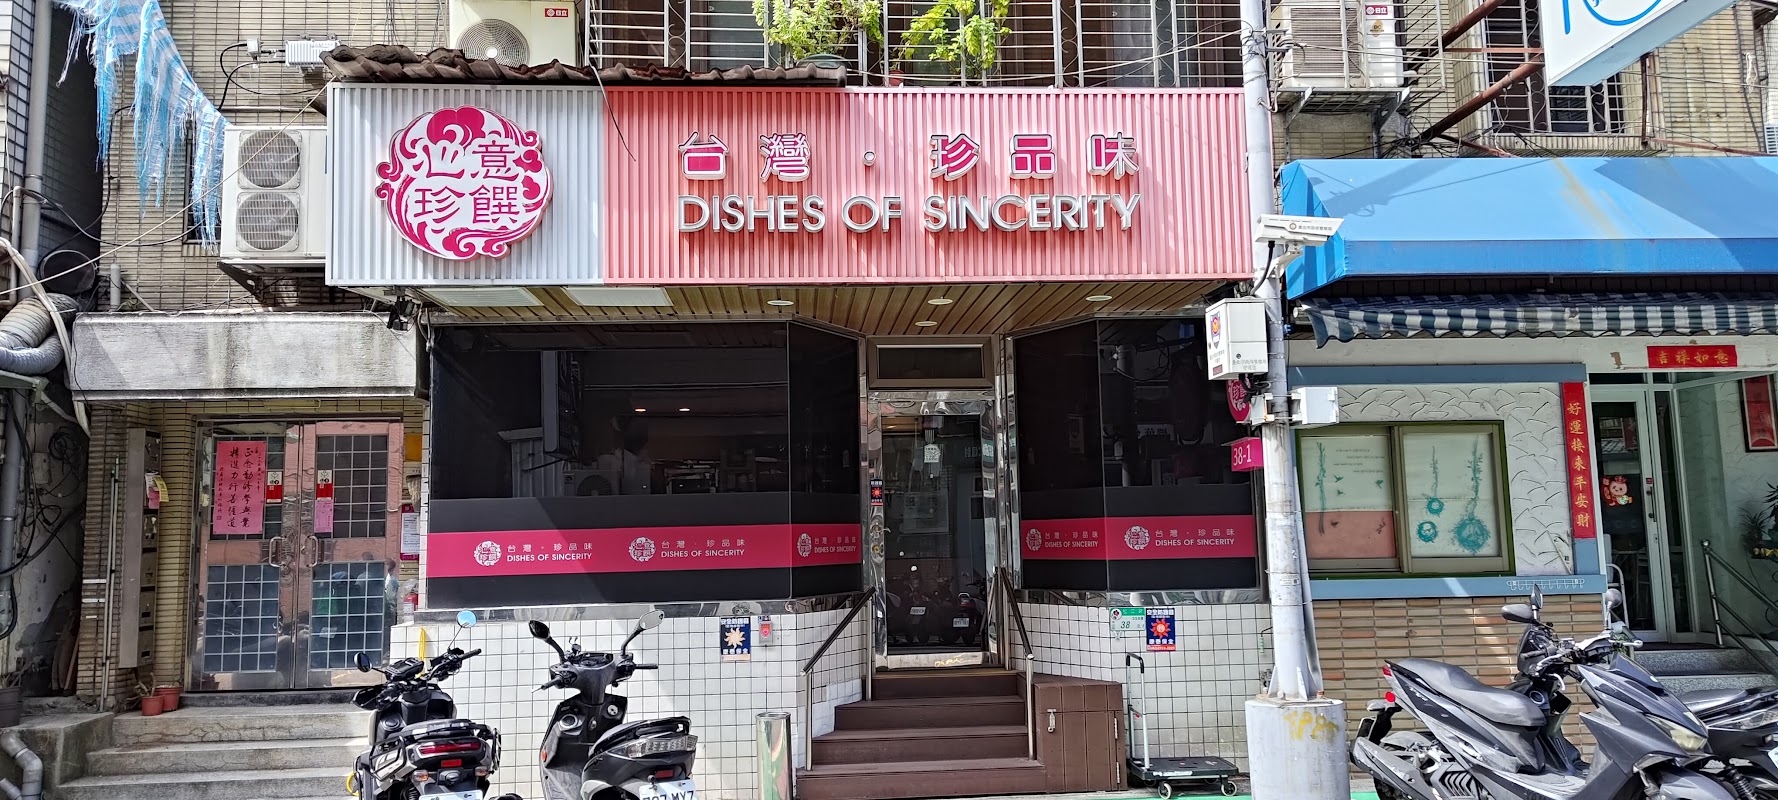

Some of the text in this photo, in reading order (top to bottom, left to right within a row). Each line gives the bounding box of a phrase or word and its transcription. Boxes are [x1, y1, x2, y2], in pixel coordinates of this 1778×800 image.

[677, 193, 1141, 234] DISHES OF SINCERITY
[1656, 350, 1730, 366] 吉祥如意
[1233, 444, 1252, 467] 38-1
[1072, 540, 1099, 548] SINCERITY
[1155, 539, 1182, 547] DISHES
[1196, 538, 1235, 546] SINCERITY
[506, 552, 593, 562] DISHES OF SINCERITY
[661, 549, 745, 558] DISHES OF SINCERITY
[1120, 621, 1131, 629] 38
